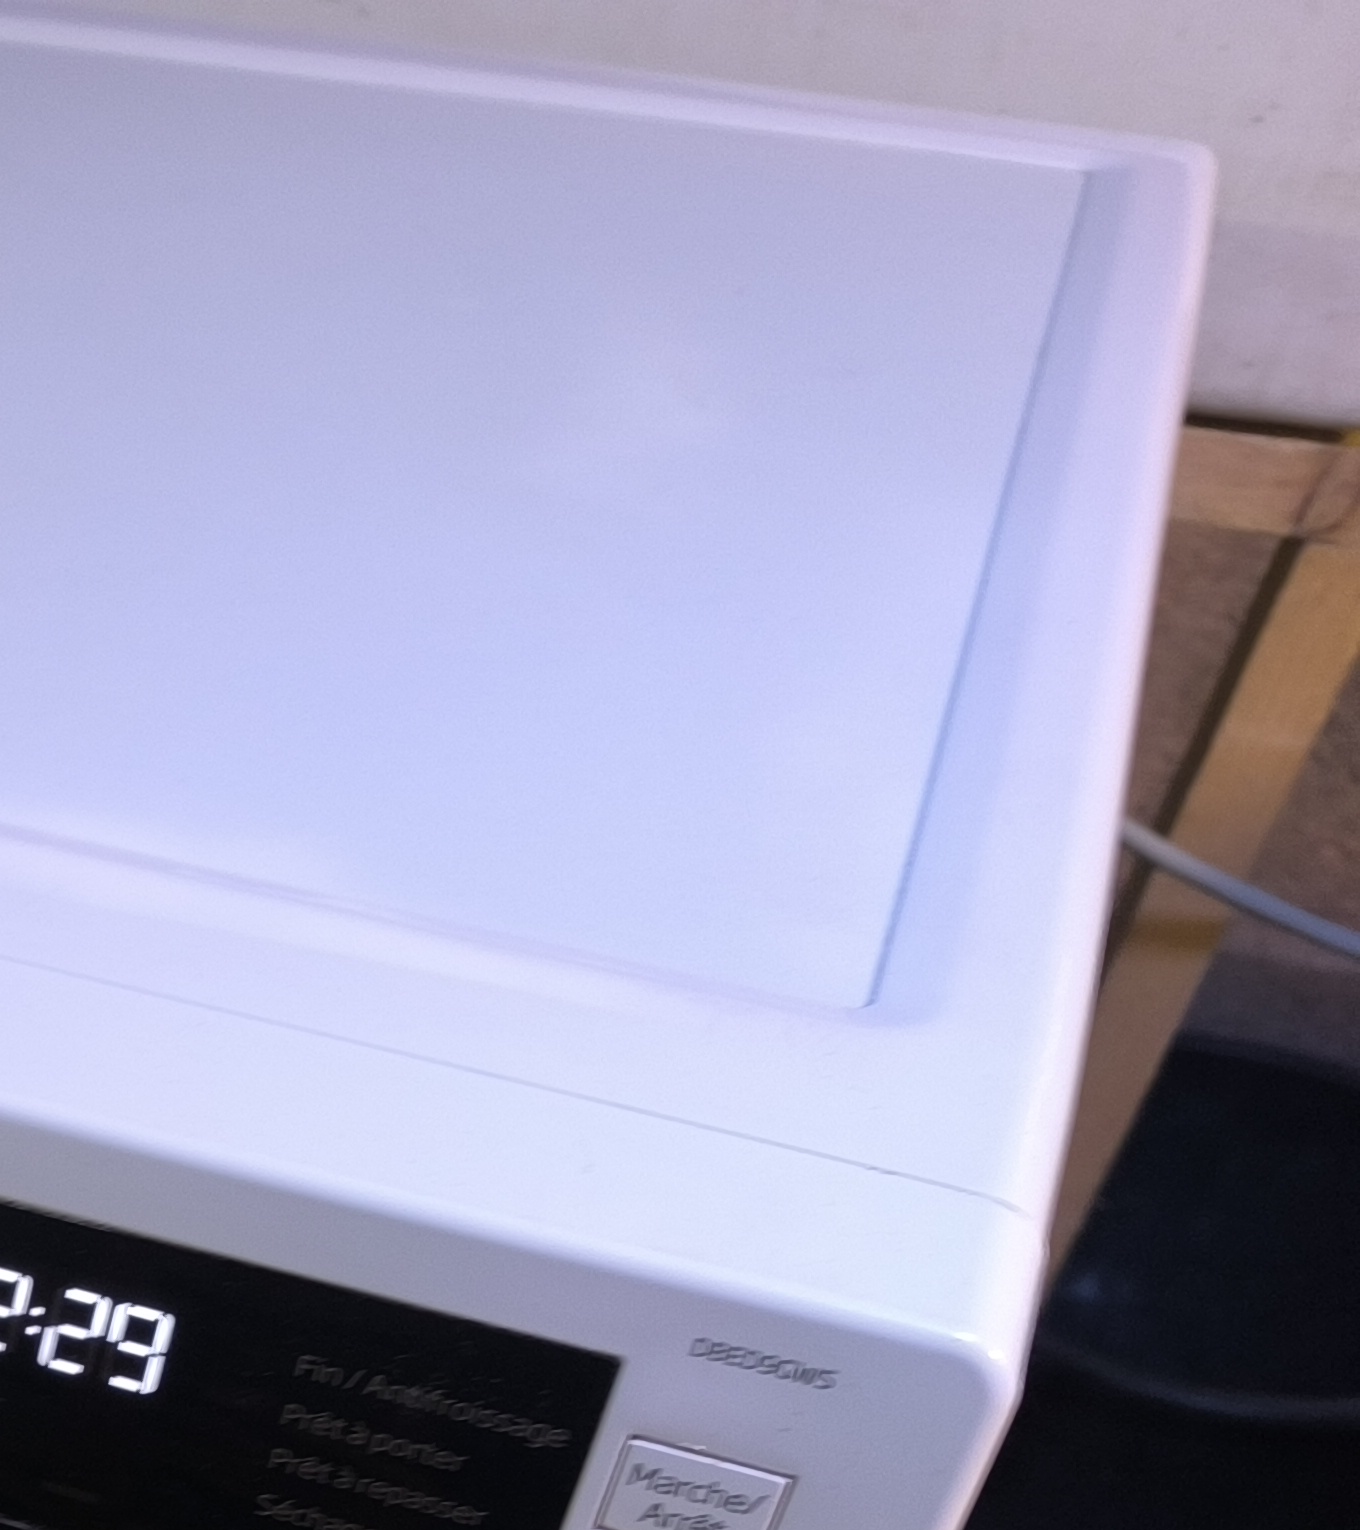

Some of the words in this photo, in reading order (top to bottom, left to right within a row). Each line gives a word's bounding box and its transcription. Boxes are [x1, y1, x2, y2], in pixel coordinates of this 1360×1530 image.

[292, 1353, 345, 1388] Fin
[277, 1401, 348, 1441] Prêt
[346, 1419, 371, 1446] à
[365, 1430, 471, 1472] porter
[266, 1446, 335, 1486] Prêt
[332, 1464, 357, 1490] à
[354, 1476, 490, 1526] repasser
[625, 1462, 773, 1515] Marche/
